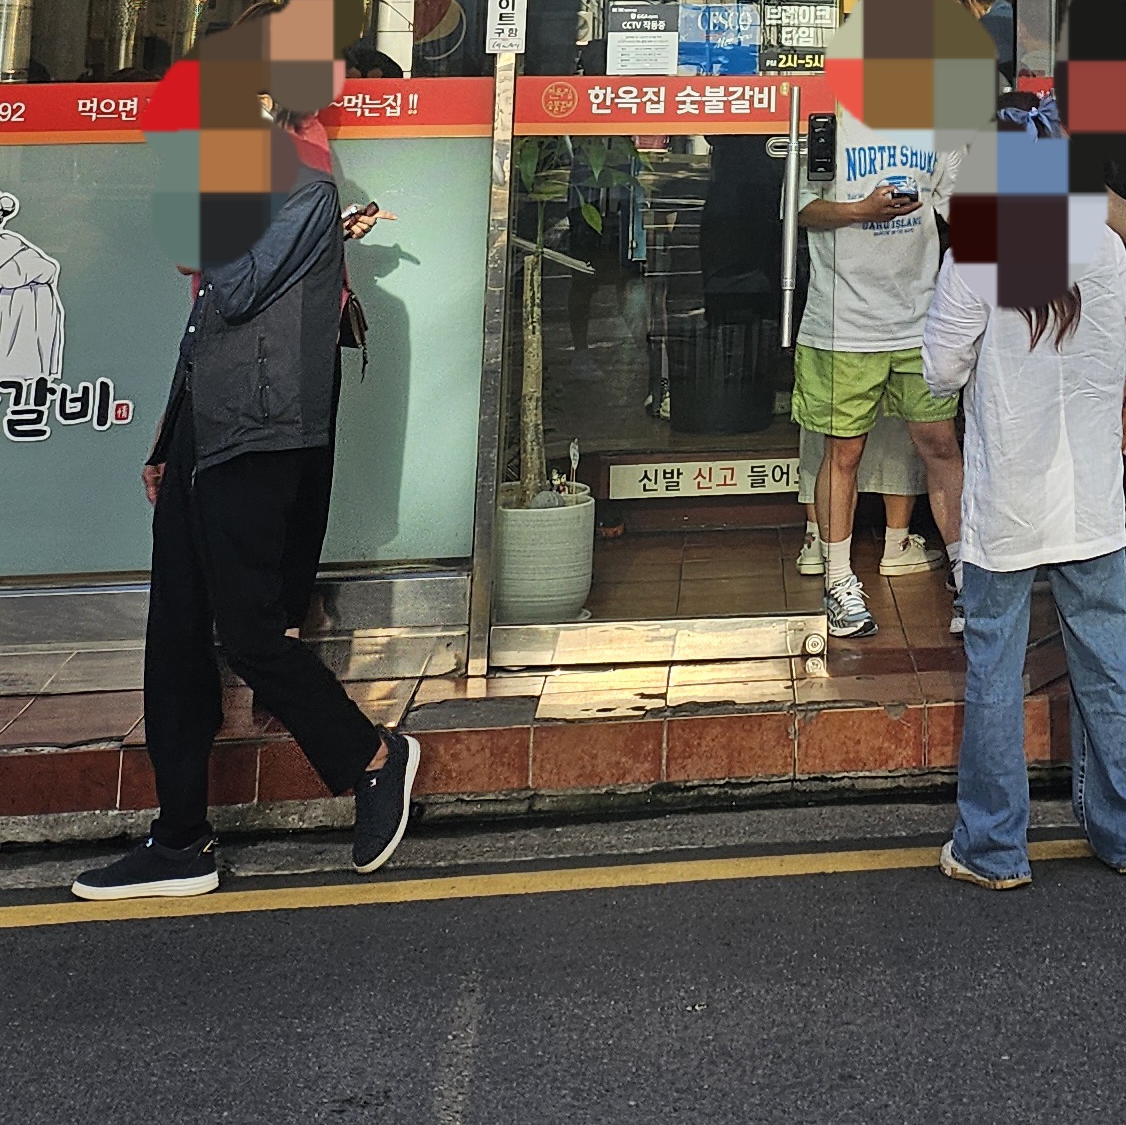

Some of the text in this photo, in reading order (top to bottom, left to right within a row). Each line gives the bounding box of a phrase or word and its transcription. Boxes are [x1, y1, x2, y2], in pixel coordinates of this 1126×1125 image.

[622, 21, 641, 30] CCTV
[765, 5, 831, 25] 브레이크
[781, 27, 814, 47] 타임
[778, 53, 824, 68] 2시-5시
[77, 97, 138, 122] 먹으면
[587, 85, 666, 114] 한옥집
[675, 84, 776, 114] 숯불갈비
[845, 145, 897, 181] NORTH
[638, 468, 683, 492] 신발
[692, 466, 738, 490] 신고
